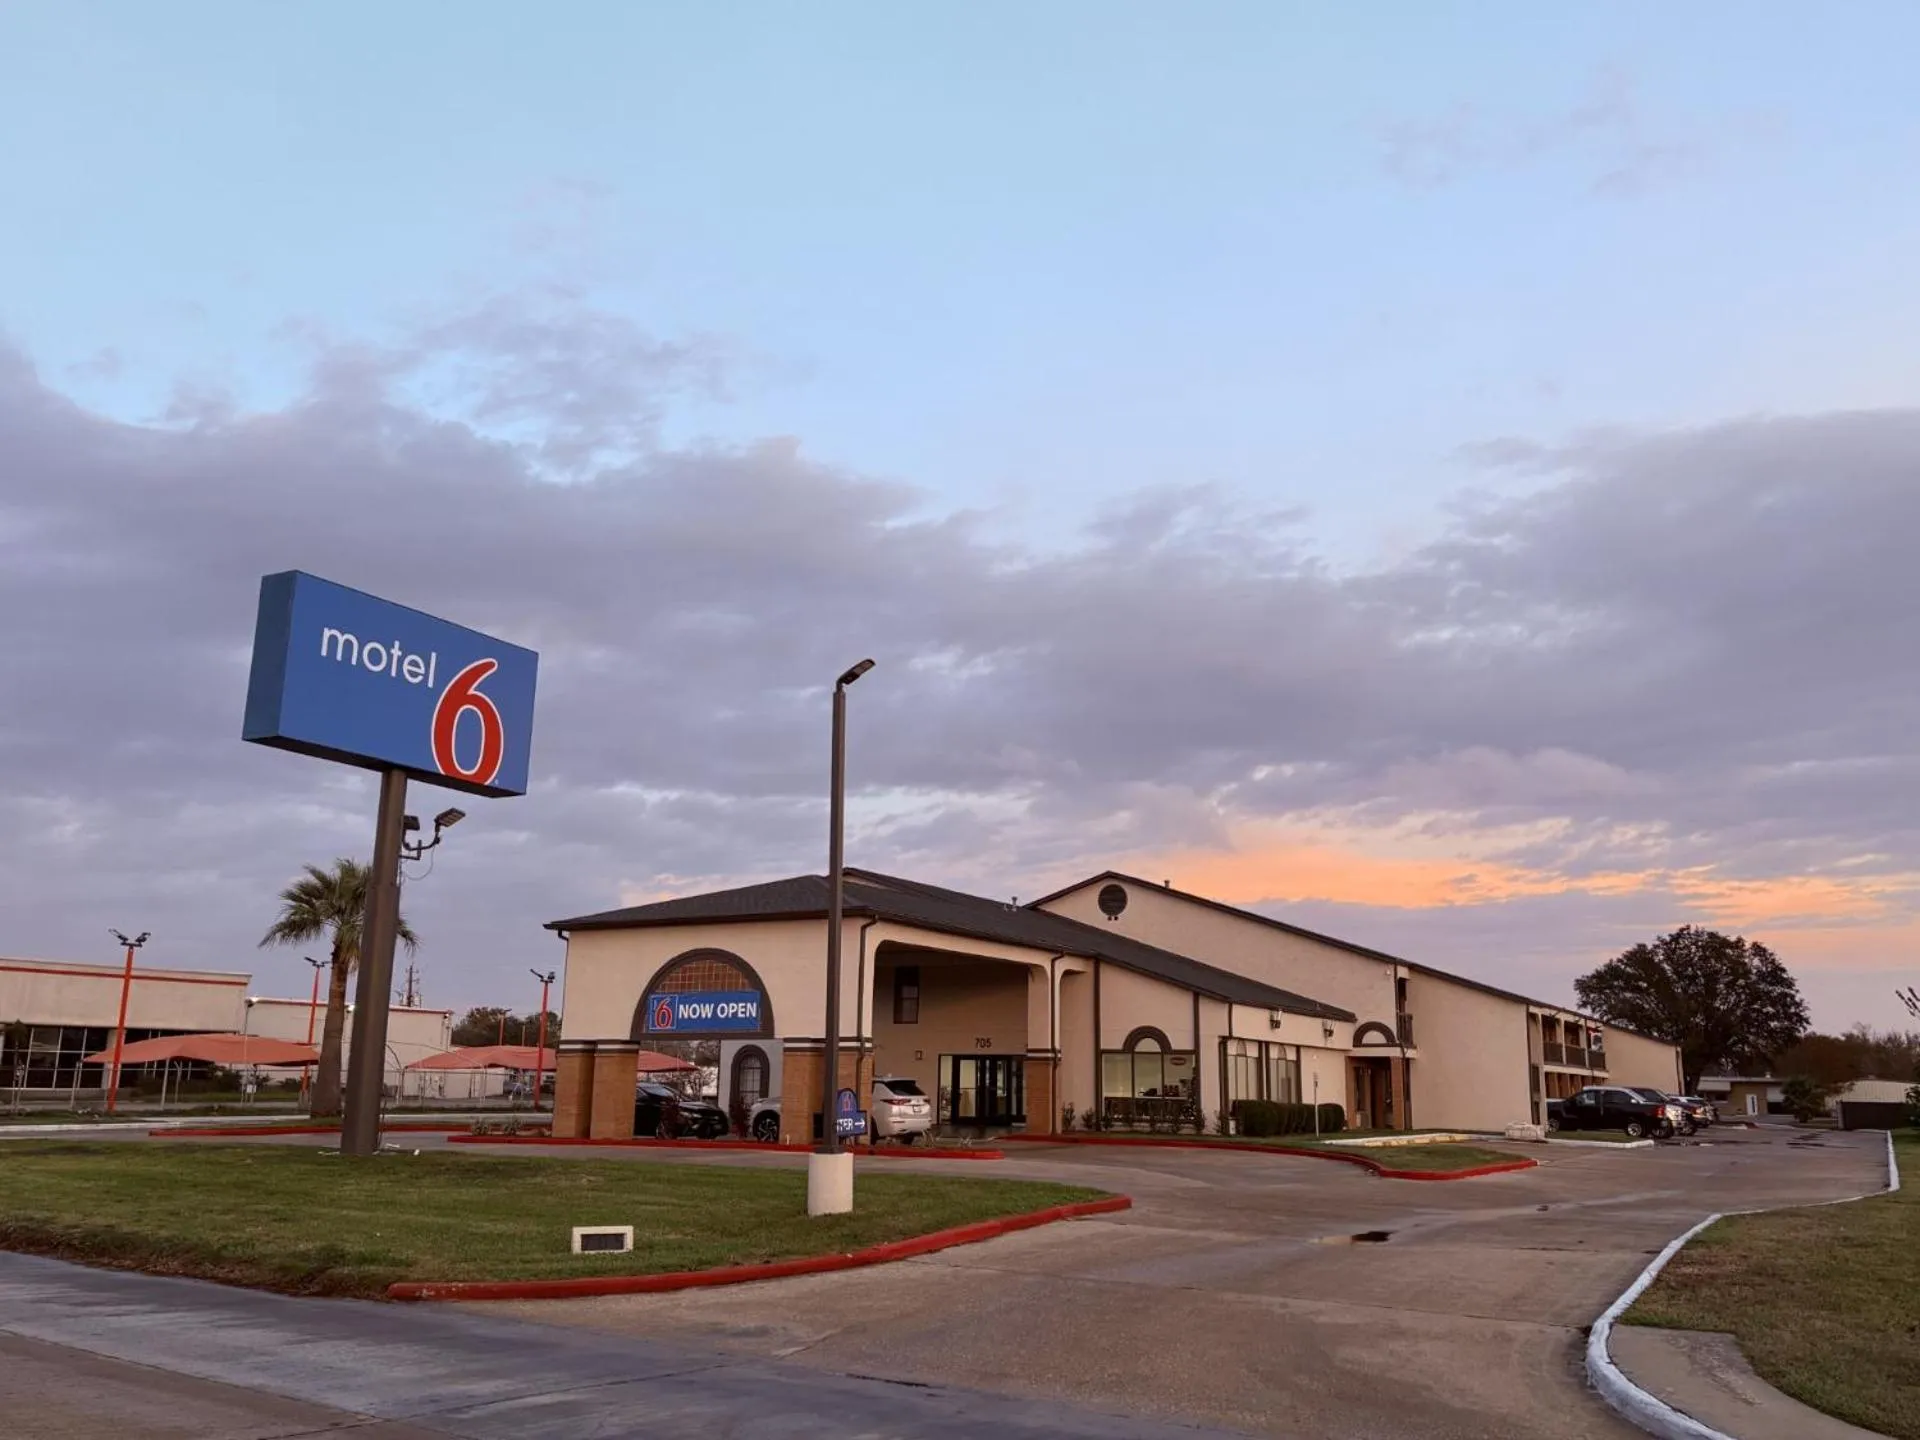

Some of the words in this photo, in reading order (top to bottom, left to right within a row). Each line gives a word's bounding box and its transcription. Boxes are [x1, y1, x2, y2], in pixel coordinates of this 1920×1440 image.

[320, 626, 437, 688] motel
[431, 657, 504, 785] 6
[655, 998, 673, 1029] 6
[678, 1002, 714, 1019] NOW
[716, 1002, 758, 1018] OPEN
[975, 1037, 992, 1048] 705
[837, 1118, 853, 1132] TER
